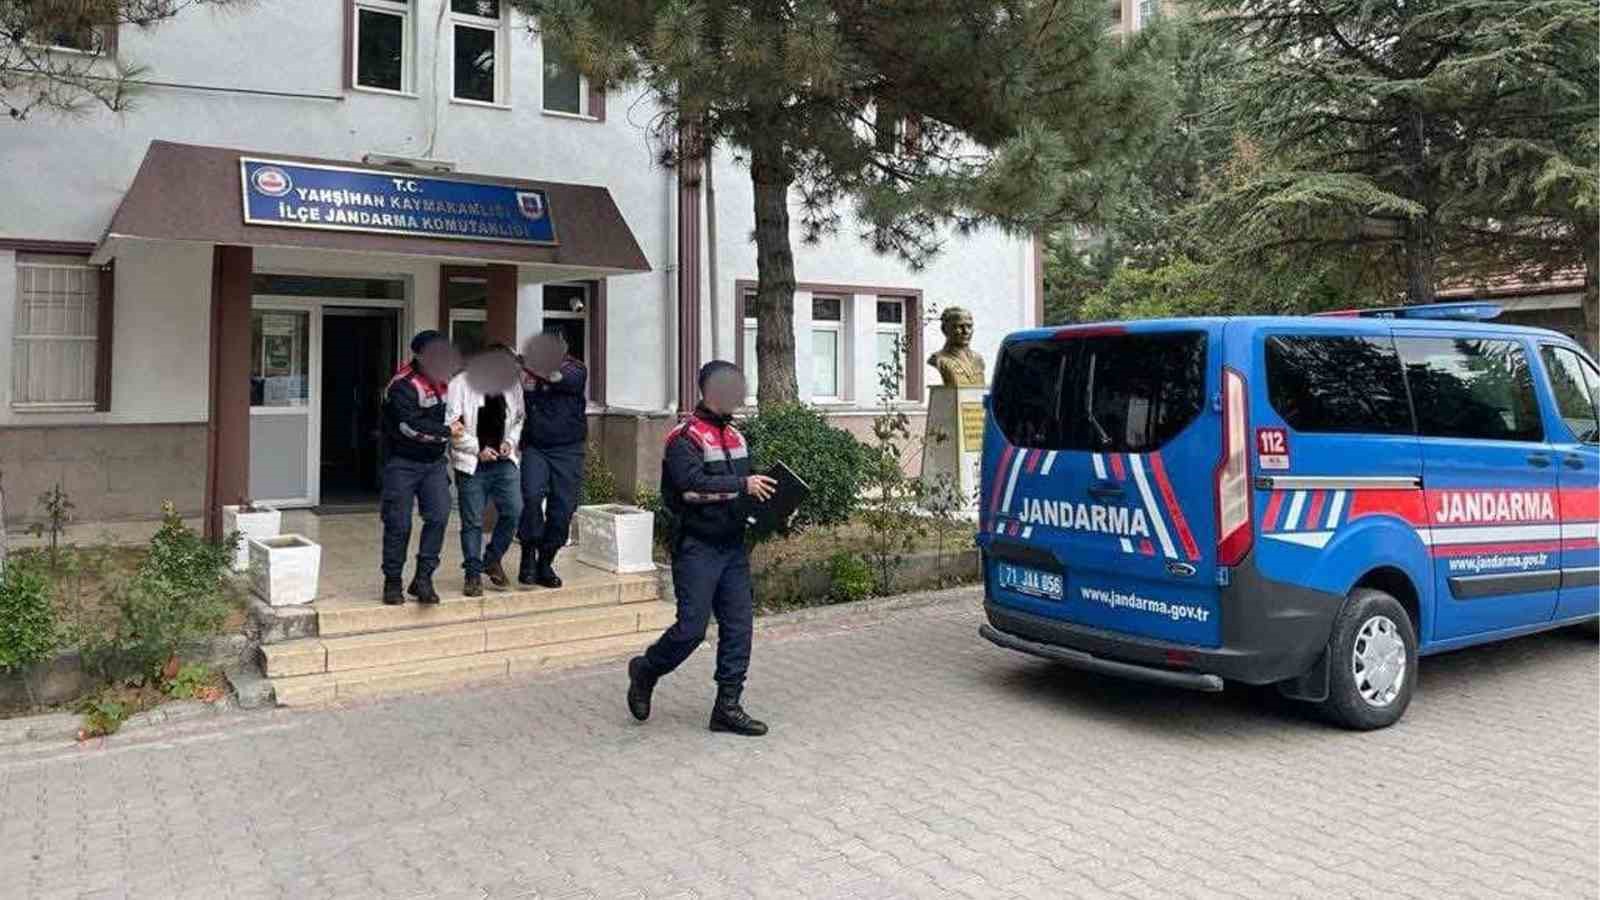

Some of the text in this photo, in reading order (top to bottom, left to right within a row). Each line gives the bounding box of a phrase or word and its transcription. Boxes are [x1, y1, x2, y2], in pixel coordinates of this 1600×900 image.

[392, 178, 423, 193] T.C.
[295, 187, 386, 207] YAHŞİHAN
[279, 200, 321, 222] İLÇE
[325, 208, 418, 228] JANDARMA
[1260, 431, 1285, 453] 112
[1018, 498, 1150, 538] JANDARMA
[1435, 492, 1554, 523] JANDARMA
[1448, 553, 1548, 573] www.jandarma.gov.tr
[1006, 566, 1017, 585] 71
[1080, 586, 1210, 622] www.jandarma.gov.tr
